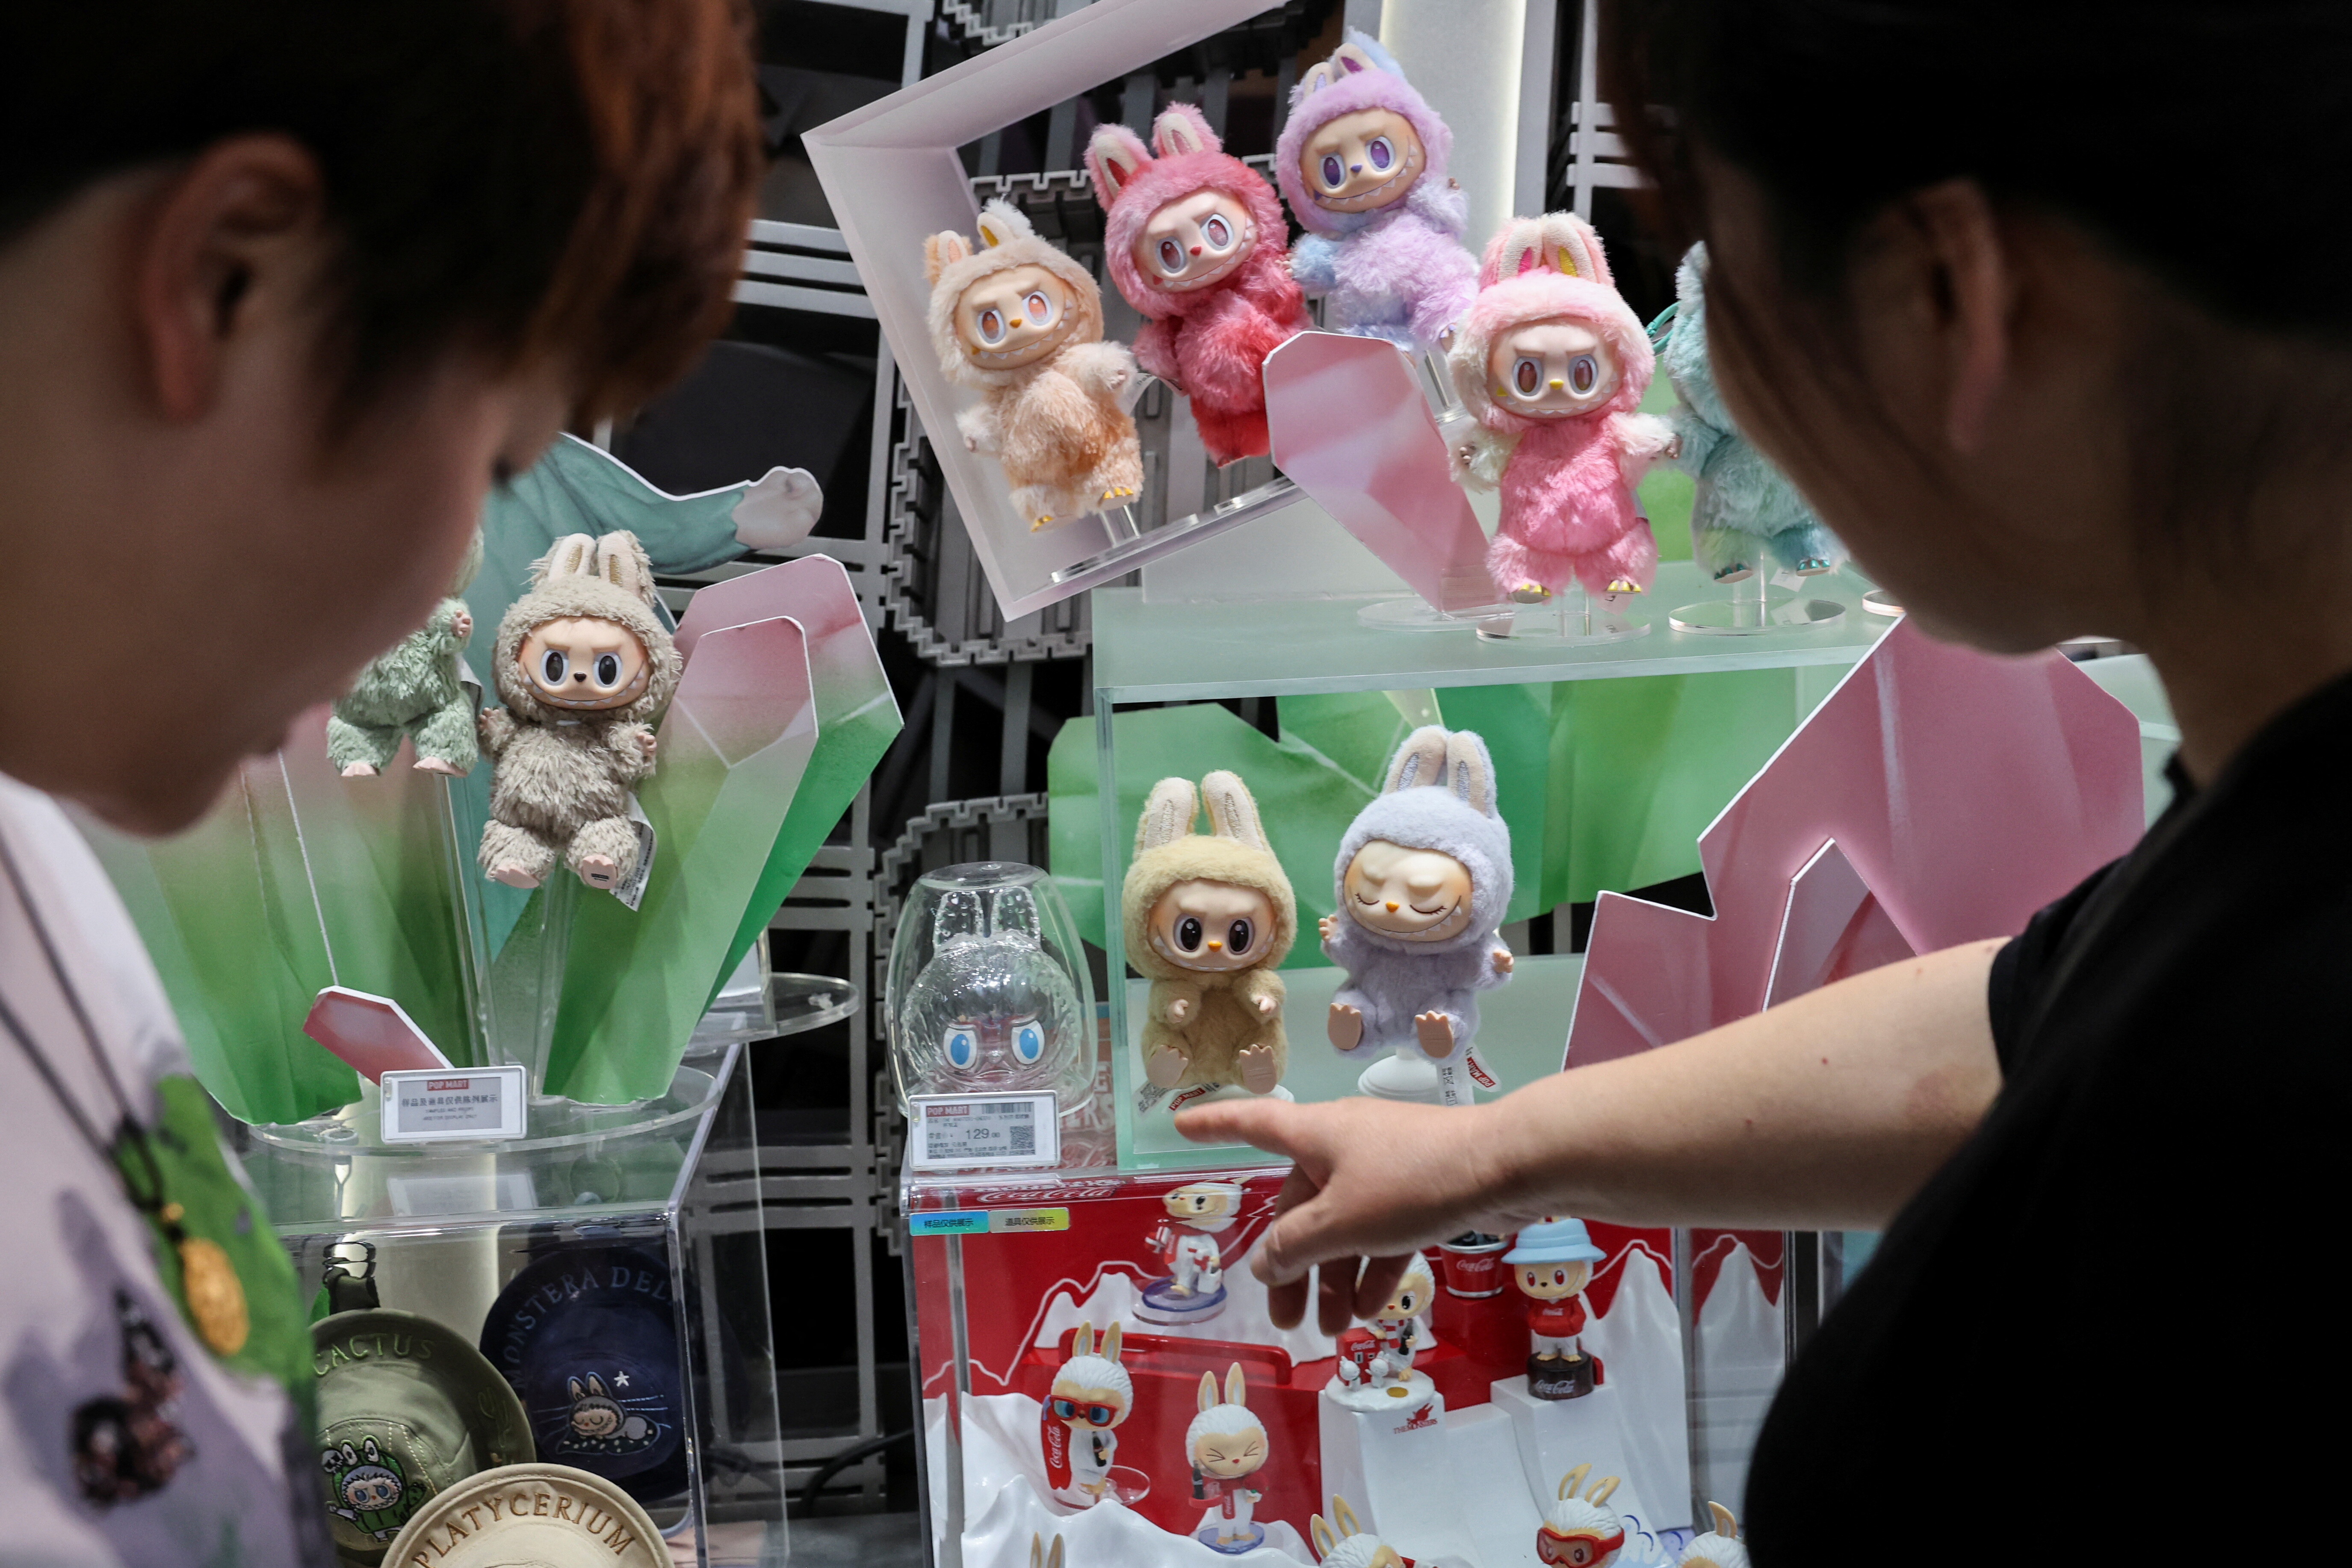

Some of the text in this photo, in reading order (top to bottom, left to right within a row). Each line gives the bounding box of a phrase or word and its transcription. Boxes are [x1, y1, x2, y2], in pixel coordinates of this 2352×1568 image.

[429, 1080, 467, 1089] POP MART
[1478, 1077, 1493, 1087] POP
[1170, 1089, 1203, 1110] POP MART
[927, 1106, 968, 1116] POP MART
[924, 1218, 974, 1228] 样品仅供展示
[1005, 1217, 1055, 1226] 道具仅供展示
[611, 1266, 672, 1305] DEL
[313, 1333, 435, 1375] CACTUS
[411, 1492, 635, 1568] PLATYCERIUM
